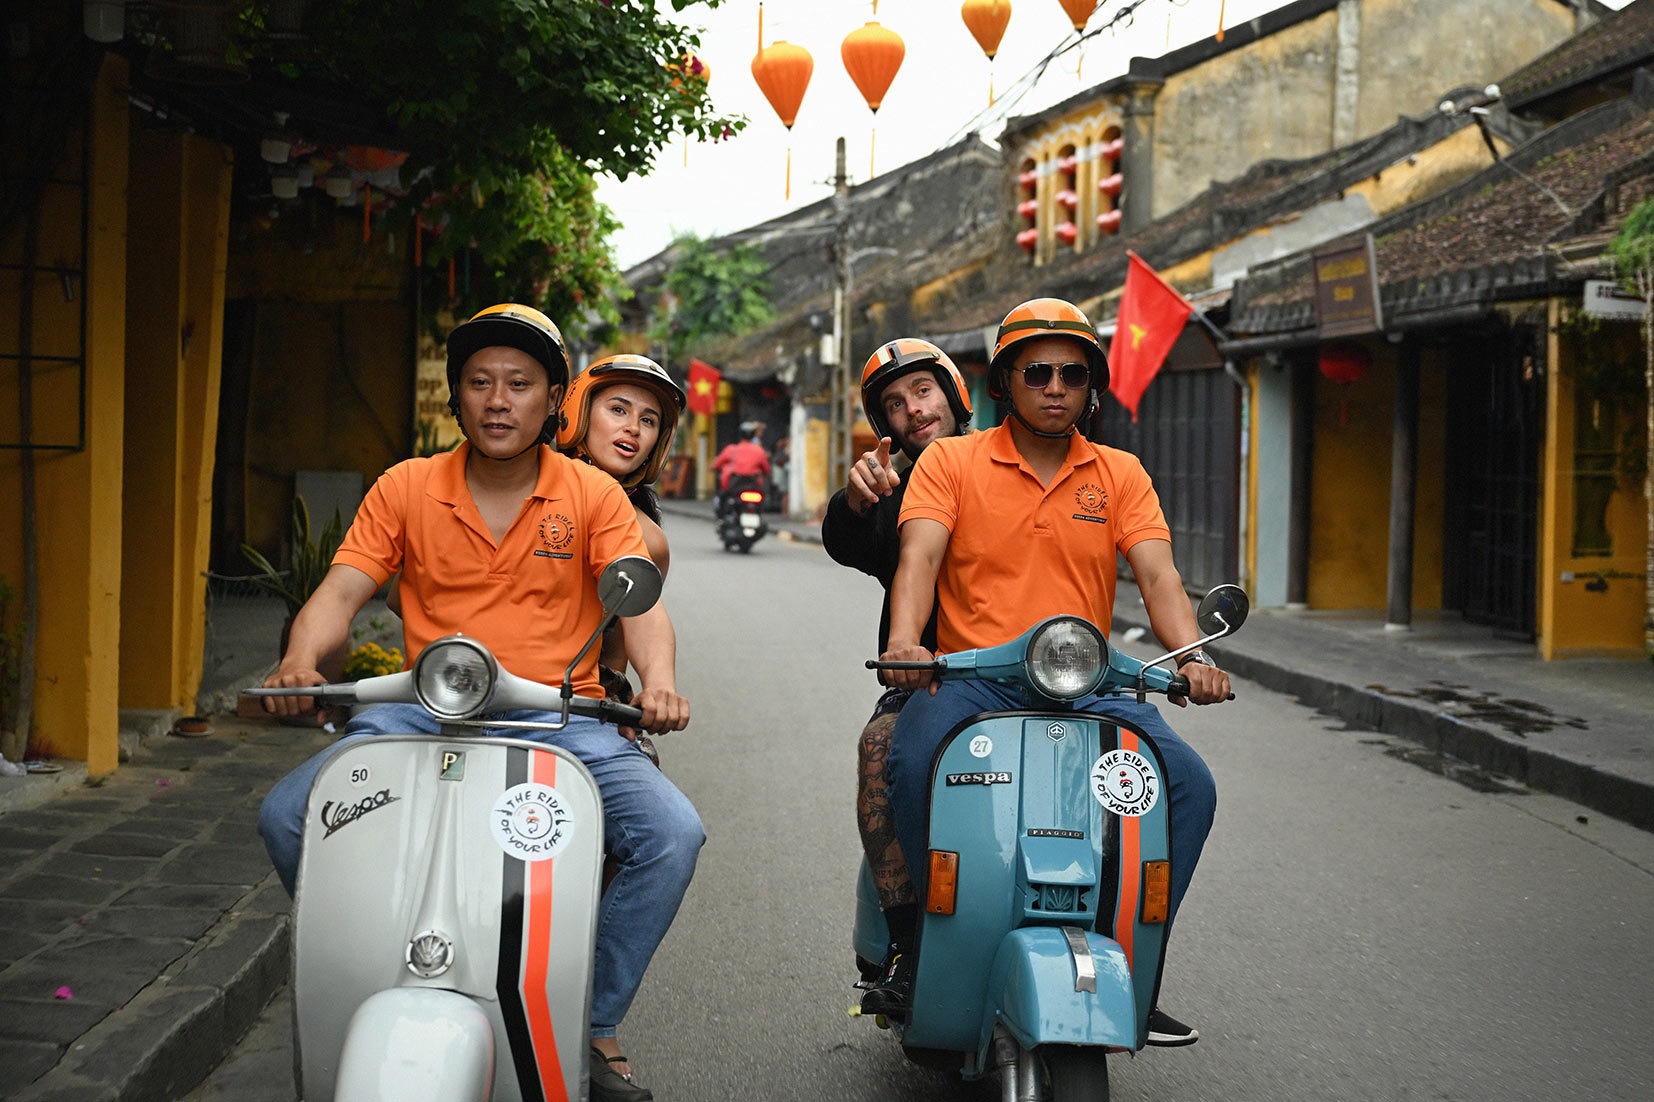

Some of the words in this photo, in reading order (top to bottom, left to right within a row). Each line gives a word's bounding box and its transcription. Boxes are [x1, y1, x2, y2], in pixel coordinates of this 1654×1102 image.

[973, 740, 989, 753] 27
[442, 753, 457, 770] P
[1099, 753, 1119, 771] THE
[1123, 752, 1150, 773] RIDE
[351, 768, 368, 783] 50
[947, 772, 1010, 785] vespa
[506, 790, 532, 808] THE
[537, 791, 565, 816] RIDE
[1097, 783, 1110, 799] OF
[1108, 799, 1140, 815] YOUR
[1140, 785, 1154, 811] LIFE
[320, 789, 398, 838] Vespa
[501, 819, 512, 835] OF
[508, 836, 540, 853] YOUR
[544, 828, 562, 850] LIFE
